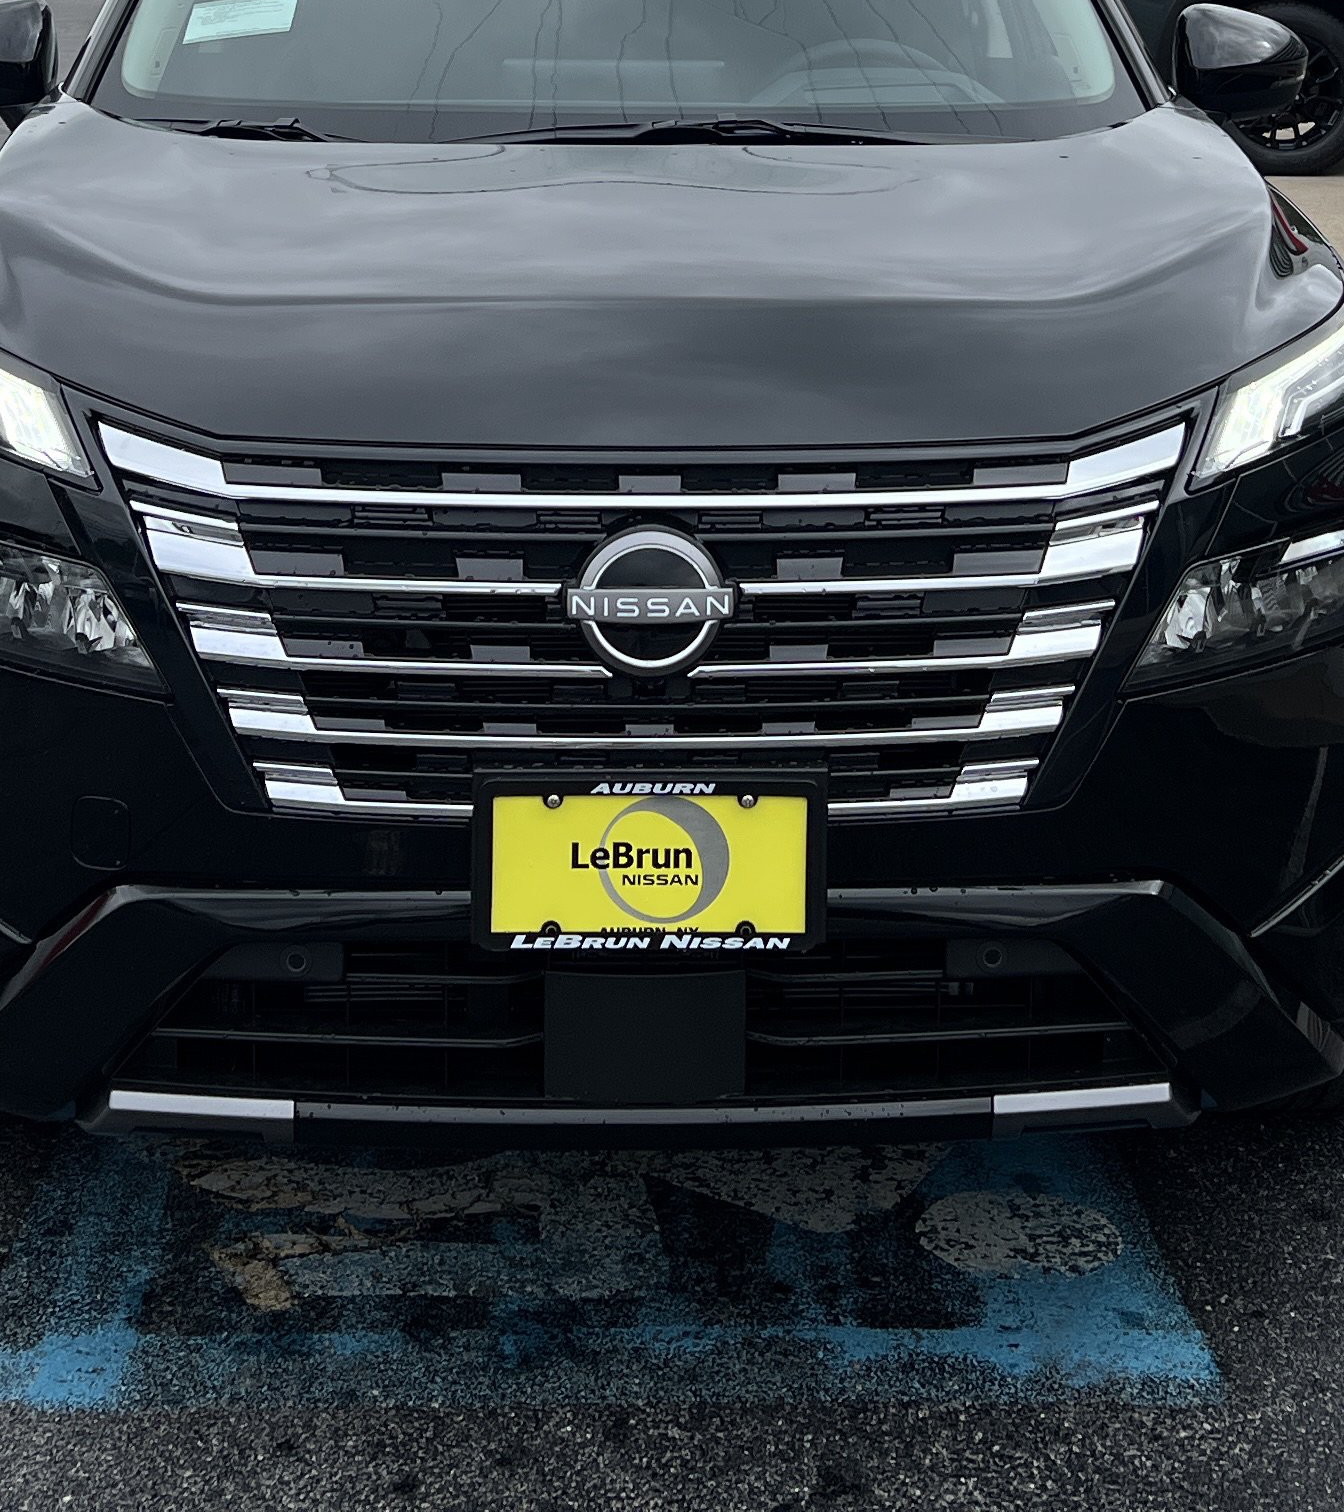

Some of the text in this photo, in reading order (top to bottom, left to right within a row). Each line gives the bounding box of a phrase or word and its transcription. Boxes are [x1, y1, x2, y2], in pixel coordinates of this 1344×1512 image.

[571, 594, 730, 618] NISSAN
[590, 782, 717, 795] AUBURN
[571, 841, 694, 870] LeBrun
[621, 873, 700, 887] NISSAN
